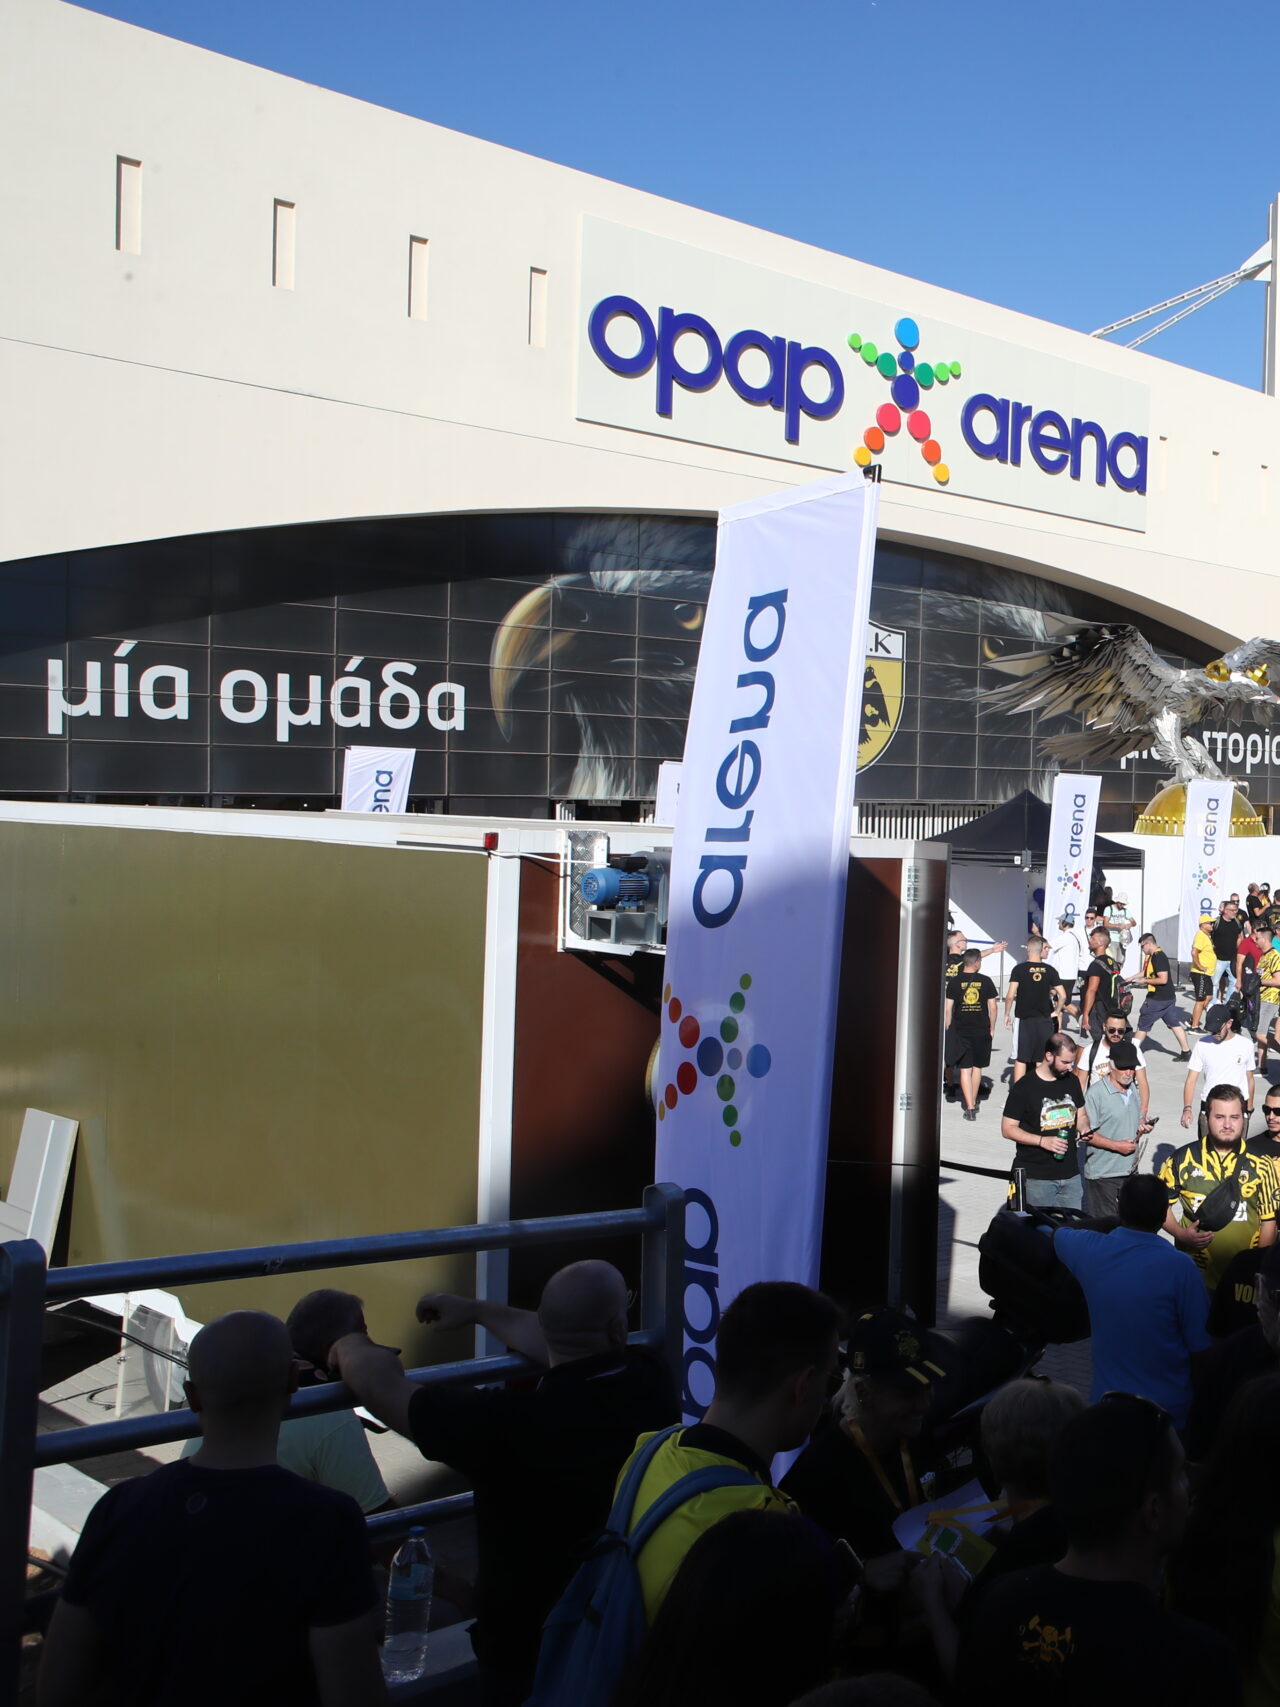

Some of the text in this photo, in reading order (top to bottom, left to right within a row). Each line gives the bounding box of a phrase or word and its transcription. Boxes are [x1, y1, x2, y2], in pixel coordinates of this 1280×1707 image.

[588, 295, 1148, 496] opap arena
[47, 640, 465, 742] μία ομάδα
[1069, 793, 1087, 858] arena
[1203, 797, 1220, 856] arena
